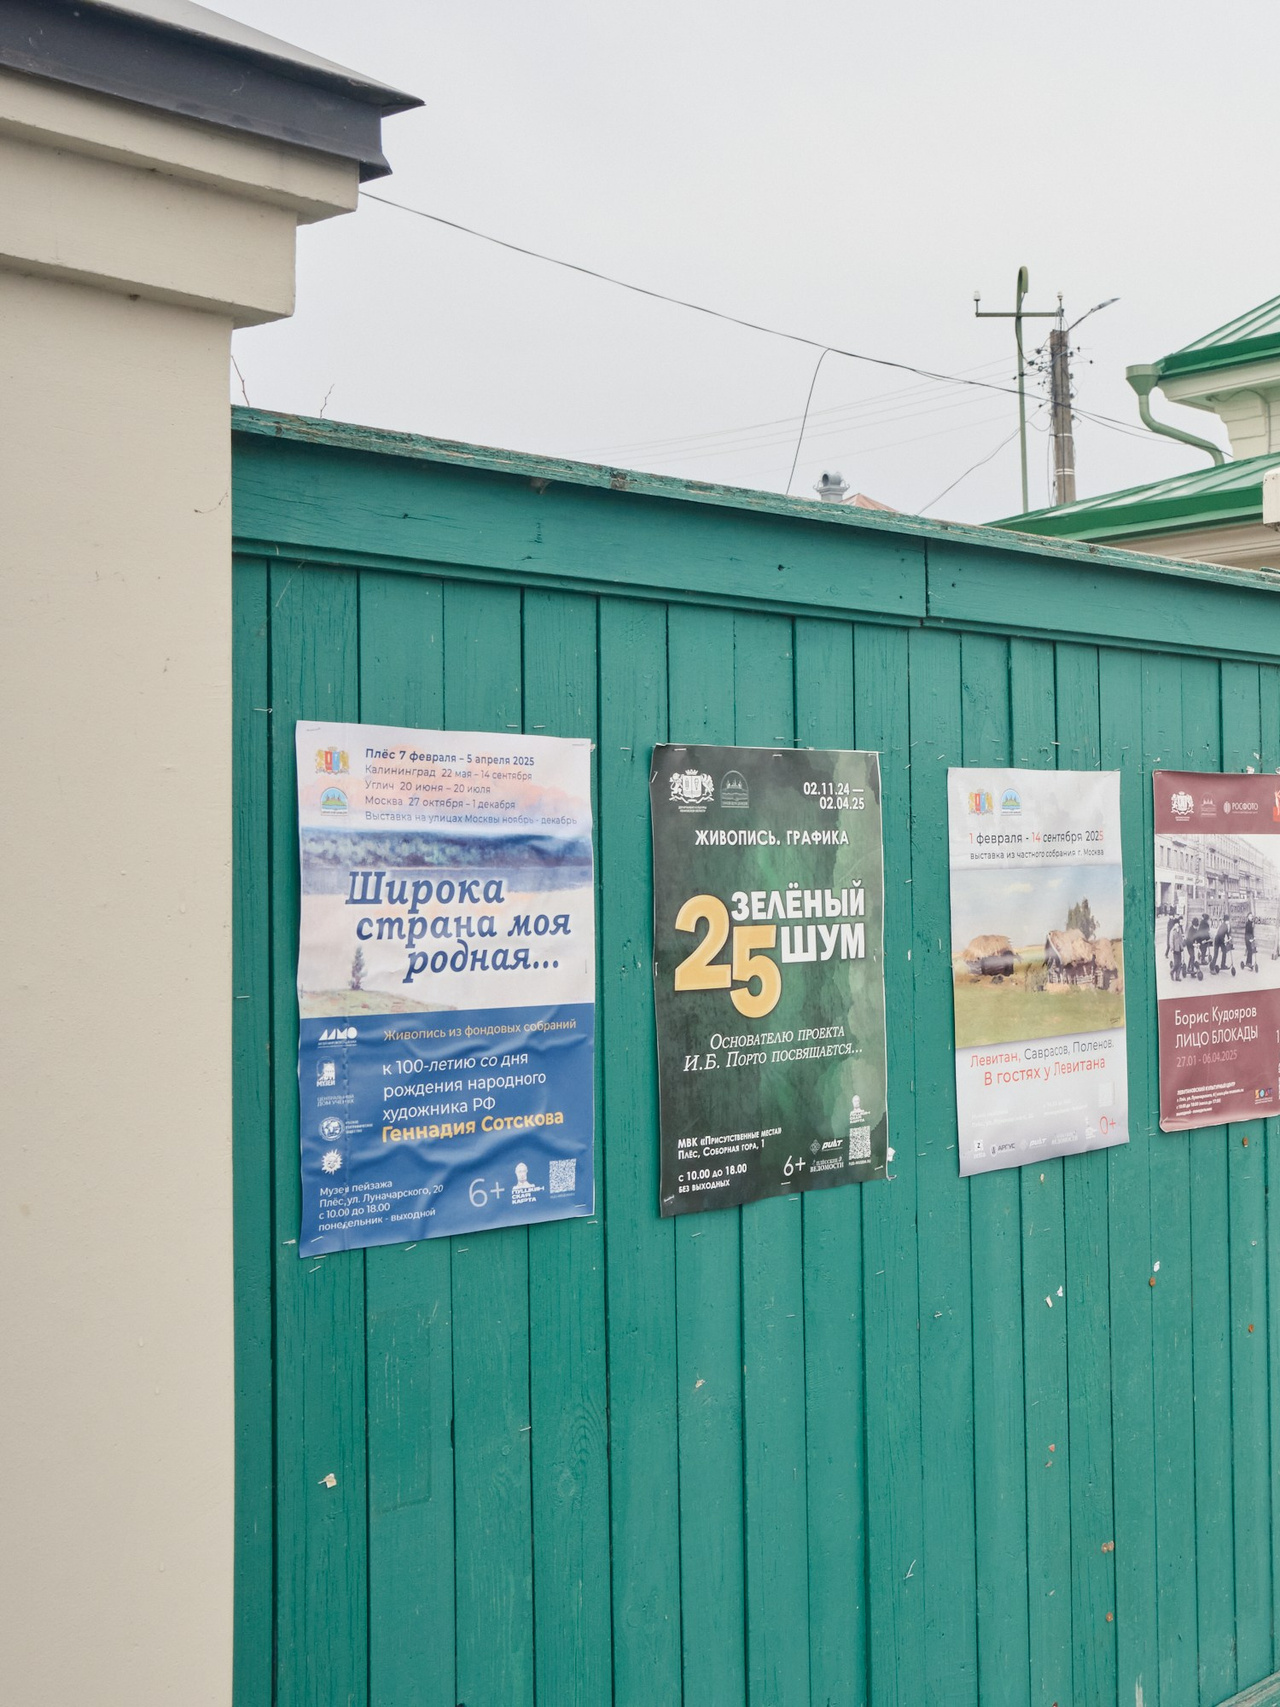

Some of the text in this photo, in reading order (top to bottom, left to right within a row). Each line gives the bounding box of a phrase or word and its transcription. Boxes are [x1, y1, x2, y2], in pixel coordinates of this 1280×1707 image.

[365, 748, 396, 760] Плёс
[399, 750, 406, 760] 7
[409, 750, 456, 764] февраля
[467, 753, 472, 763] 5
[475, 756, 510, 767] апреля
[512, 756, 535, 766] 2025
[365, 764, 532, 782] Калининград 22 мая 14 сентября
[365, 780, 491, 794] Углич 20 июня 20 июля
[803, 782, 850, 796] 02.11.24
[365, 796, 516, 811] Москва 27 октября 1 декабря
[819, 796, 865, 810] 02.04.25
[1232, 802, 1258, 811] РОСФОТО
[365, 811, 412, 822] Выставка
[415, 814, 426, 822] на
[428, 814, 463, 824] улицах
[464, 814, 500, 824] Москвы
[502, 815, 534, 826] ноябрь
[541, 814, 578, 827] декабрь
[695, 829, 849, 846] ЖИВОПИСЬ. ГРАФИКА
[969, 830, 1104, 846] 1 февраля 14 сентября 2025
[970, 851, 1004, 860] выставка
[1016, 850, 1044, 860] частного
[1045, 849, 1076, 860] собрания
[1083, 848, 1104, 856] Москва
[345, 871, 505, 914] Широка
[731, 879, 865, 922] ЗЕЛЁНЫЙ
[356, 912, 572, 948] страна моя
[780, 923, 865, 963] ШУМ
[403, 939, 559, 984] родная...
[674, 894, 782, 1018] 25
[1174, 1006, 1257, 1028] Борис Кудояров
[384, 1018, 577, 1042] Живопись из фондовых собраний
[1175, 1025, 1258, 1048] ЛИЦО БЛОКАДЫ
[382, 1053, 528, 1076] к 100-летию со дня
[683, 1054, 720, 1072] И.Б.
[970, 1052, 1022, 1068] Левитан,
[1024, 1045, 1070, 1061] Саврасов,
[1176, 1050, 1238, 1068] 27.01 06.04.2025
[984, 1056, 1106, 1086] В гостях у Левитана
[383, 1072, 546, 1100] рождения народного
[382, 1096, 496, 1122] художника РФ
[382, 1111, 564, 1143] Геннадия Сотскова
[1100, 1115, 1116, 1134] 0+
[678, 1138, 698, 1148] МВК
[761, 1138, 765, 1148] 1
[686, 1169, 710, 1180] 10.00
[725, 1163, 748, 1176] 18.00
[784, 1155, 806, 1176] 6+
[352, 1180, 392, 1192] пейзажа
[362, 1188, 431, 1203] Луначарского,
[433, 1184, 444, 1194] 20
[469, 1178, 505, 1207] 6+
[318, 1202, 390, 1220] с 10.00 до 18.00
[390, 1208, 436, 1222] выходной
